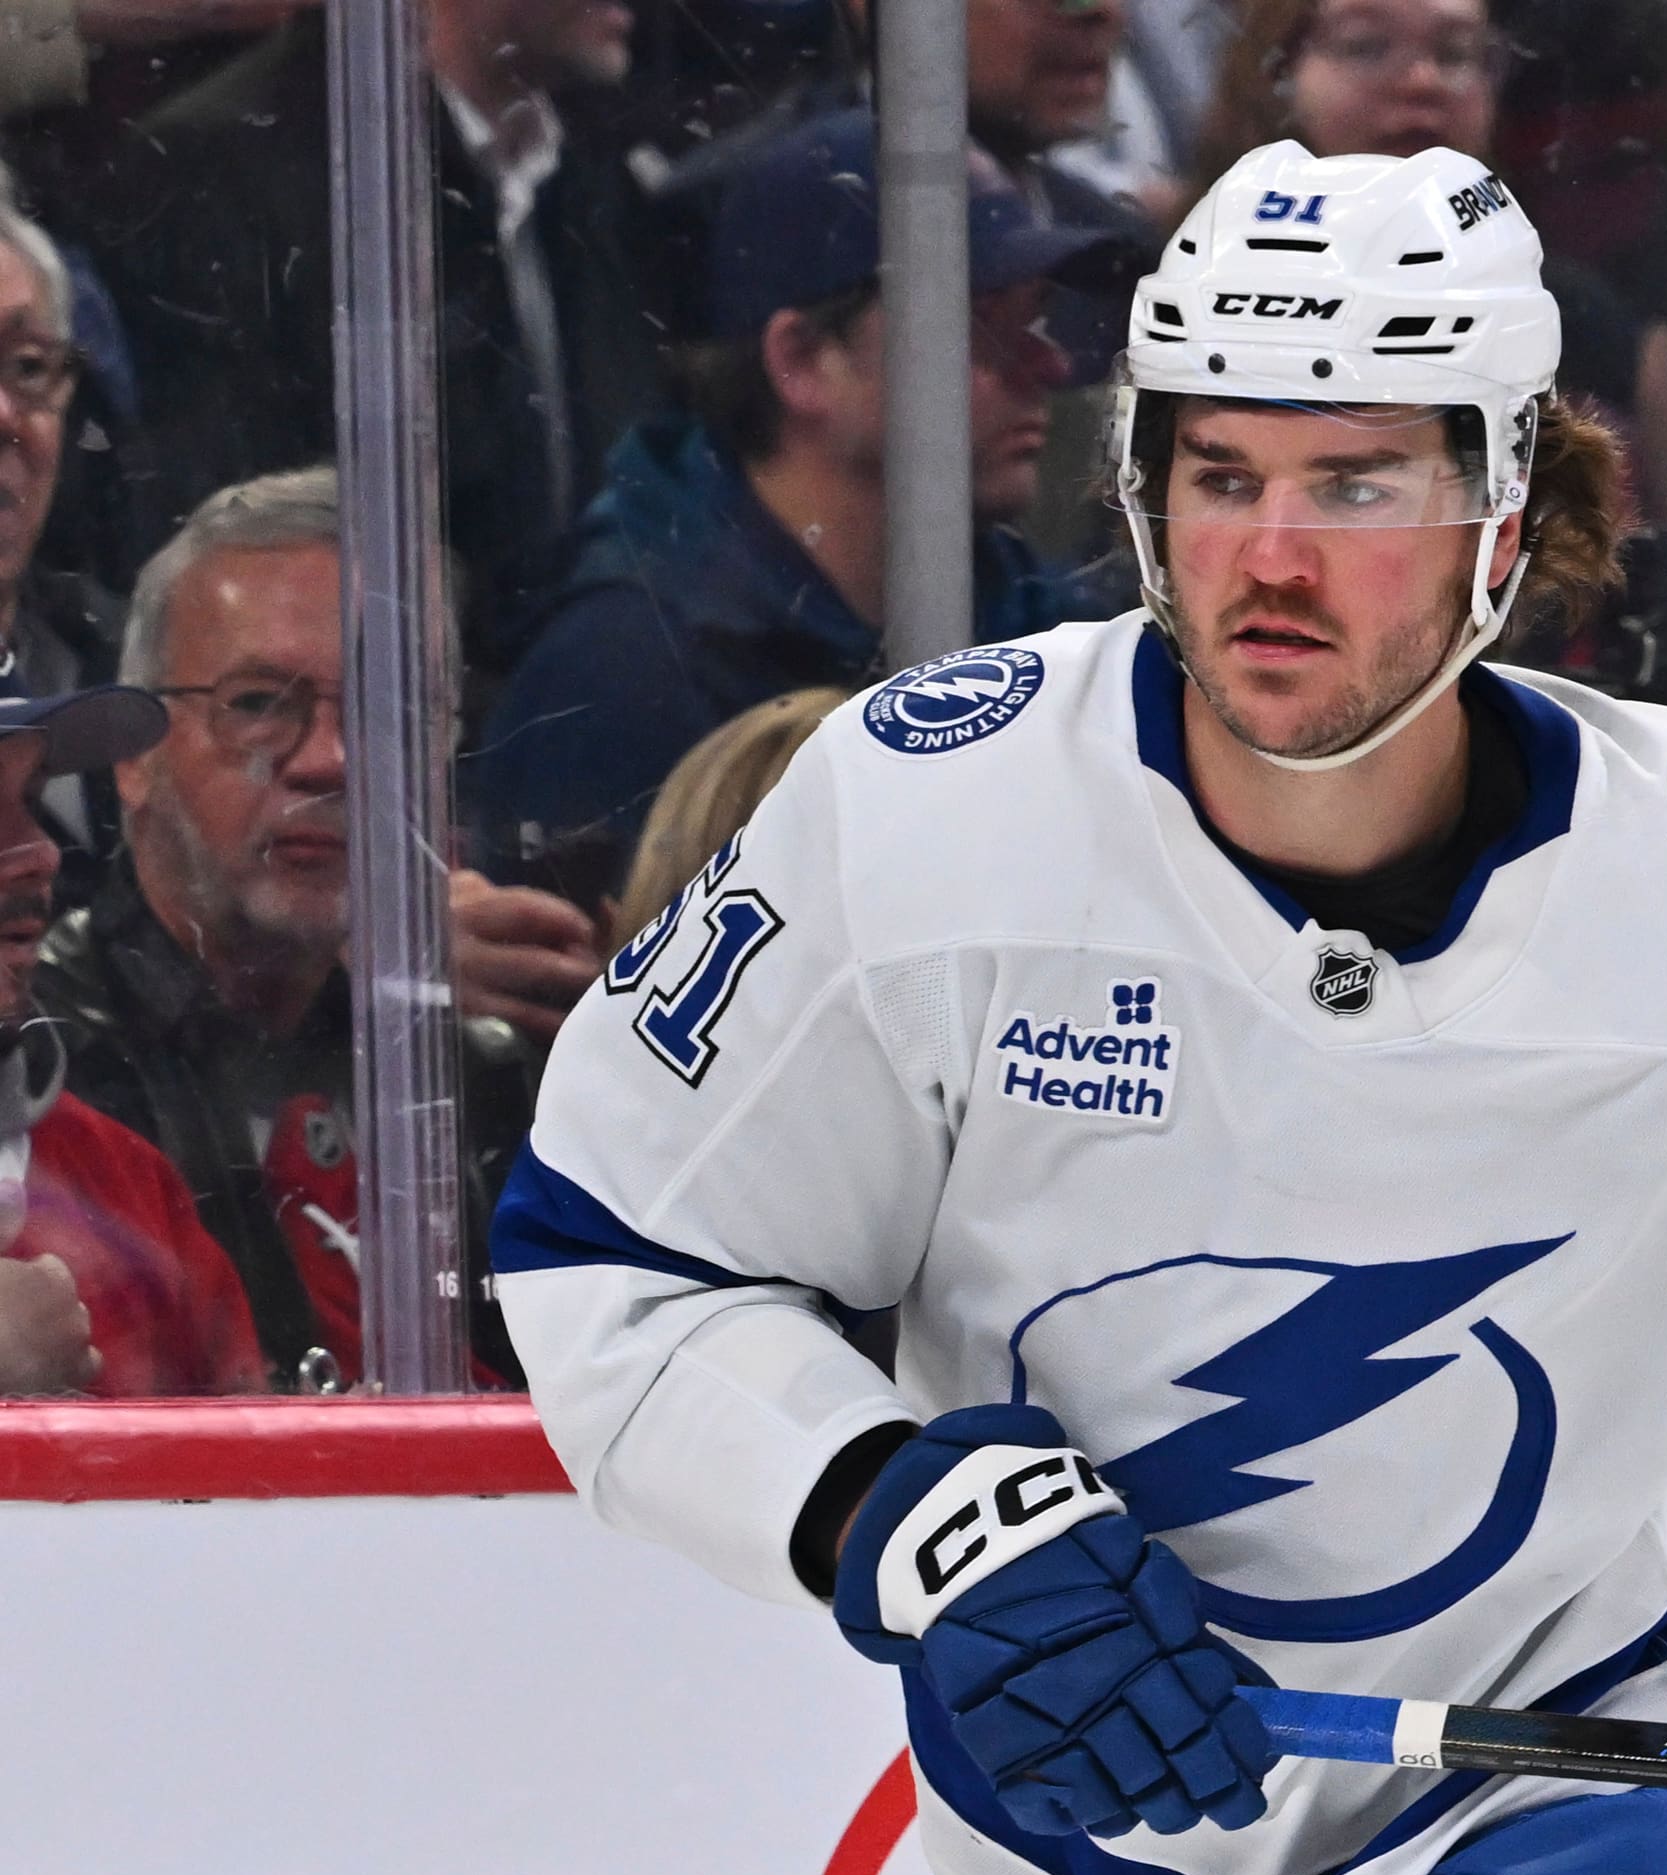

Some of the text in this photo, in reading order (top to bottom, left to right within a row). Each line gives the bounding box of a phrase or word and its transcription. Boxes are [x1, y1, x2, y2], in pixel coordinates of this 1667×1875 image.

[1254, 190, 1328, 226] 51
[1211, 292, 1345, 321] CCM
[903, 650, 1039, 749] TAMPA BAY LIGHTNING
[1321, 970, 1367, 999] NHL
[998, 1018, 1172, 1071] Advent
[1003, 1061, 1164, 1118] Health
[434, 1271, 459, 1298] 16
